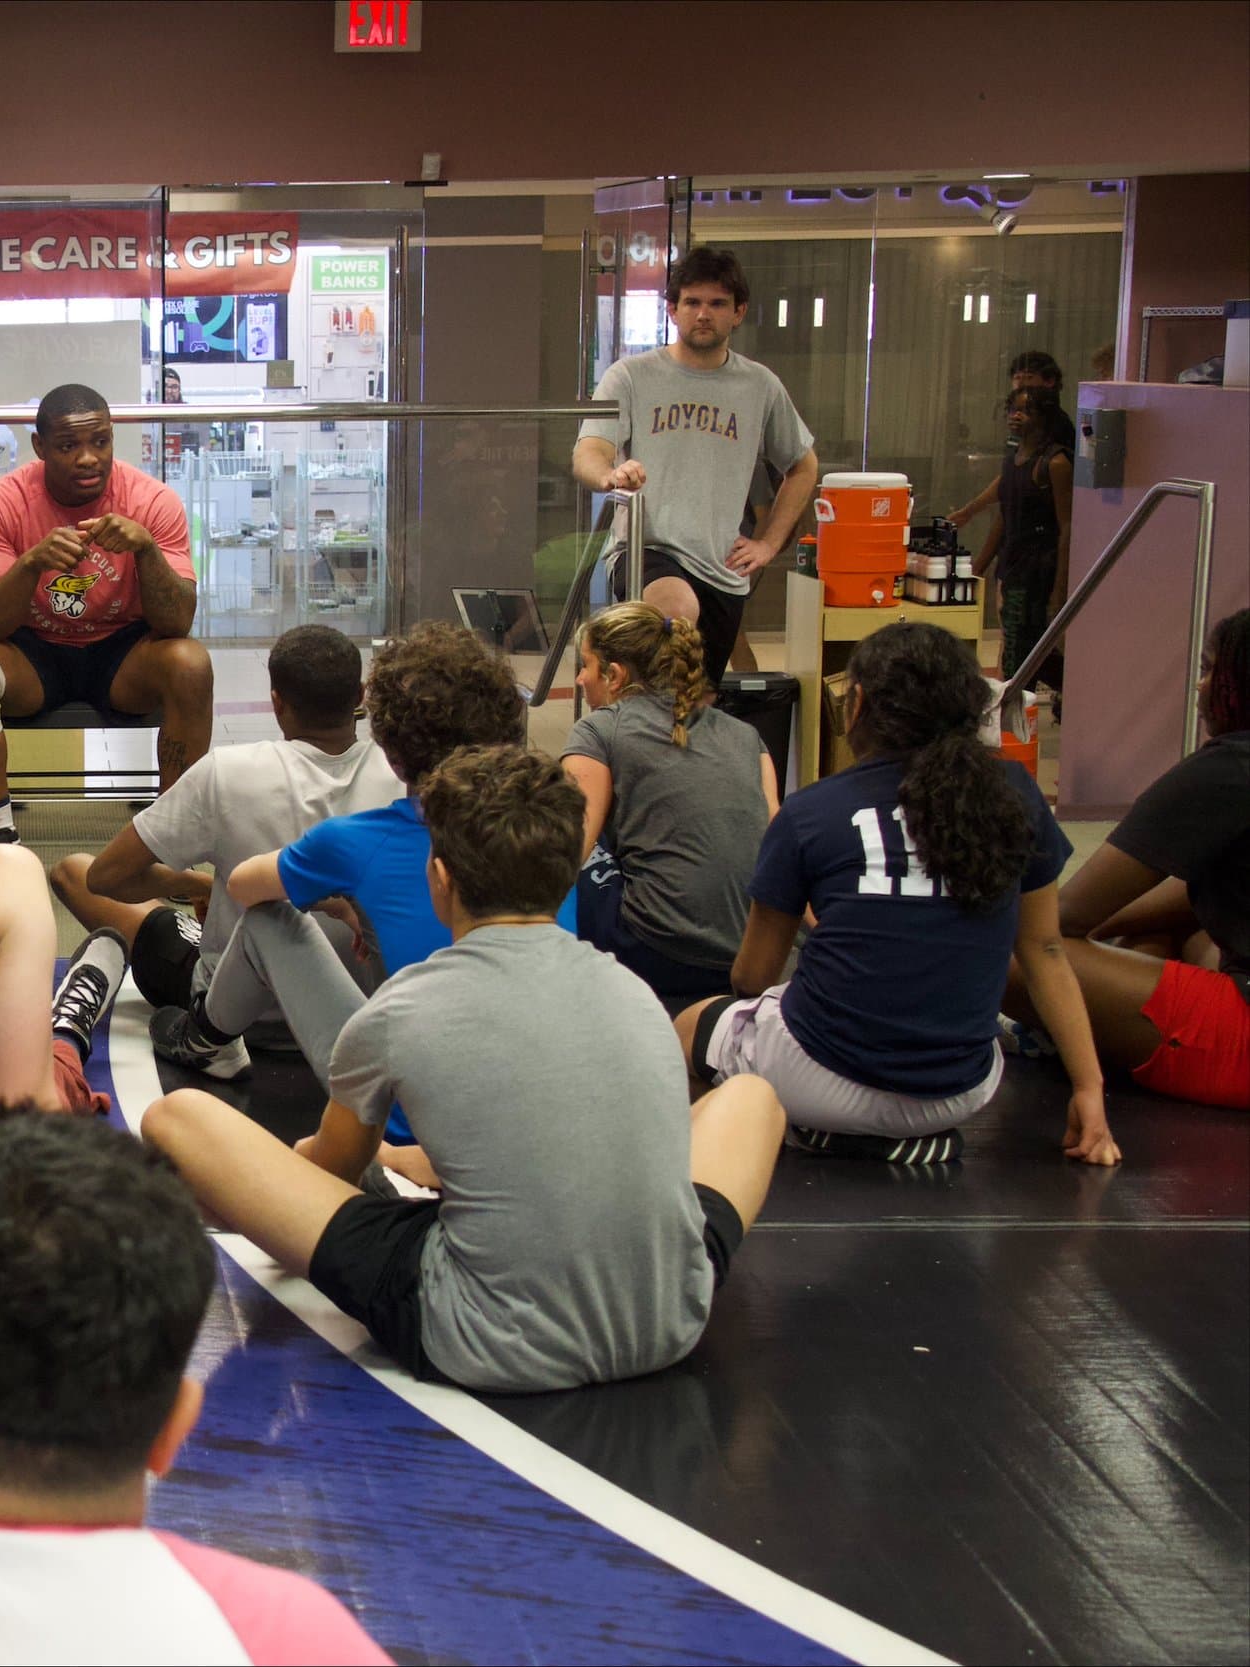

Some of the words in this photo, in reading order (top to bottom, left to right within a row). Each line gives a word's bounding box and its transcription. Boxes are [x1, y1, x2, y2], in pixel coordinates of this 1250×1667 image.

[349, 0, 413, 46] EXIT
[31, 236, 138, 272] CARE
[146, 236, 180, 270] &
[183, 230, 293, 270] GIFTS
[319, 259, 380, 274] POWER
[320, 275, 379, 289] BANKS
[650, 403, 739, 441] LOYOLA
[84, 547, 121, 582] CURY
